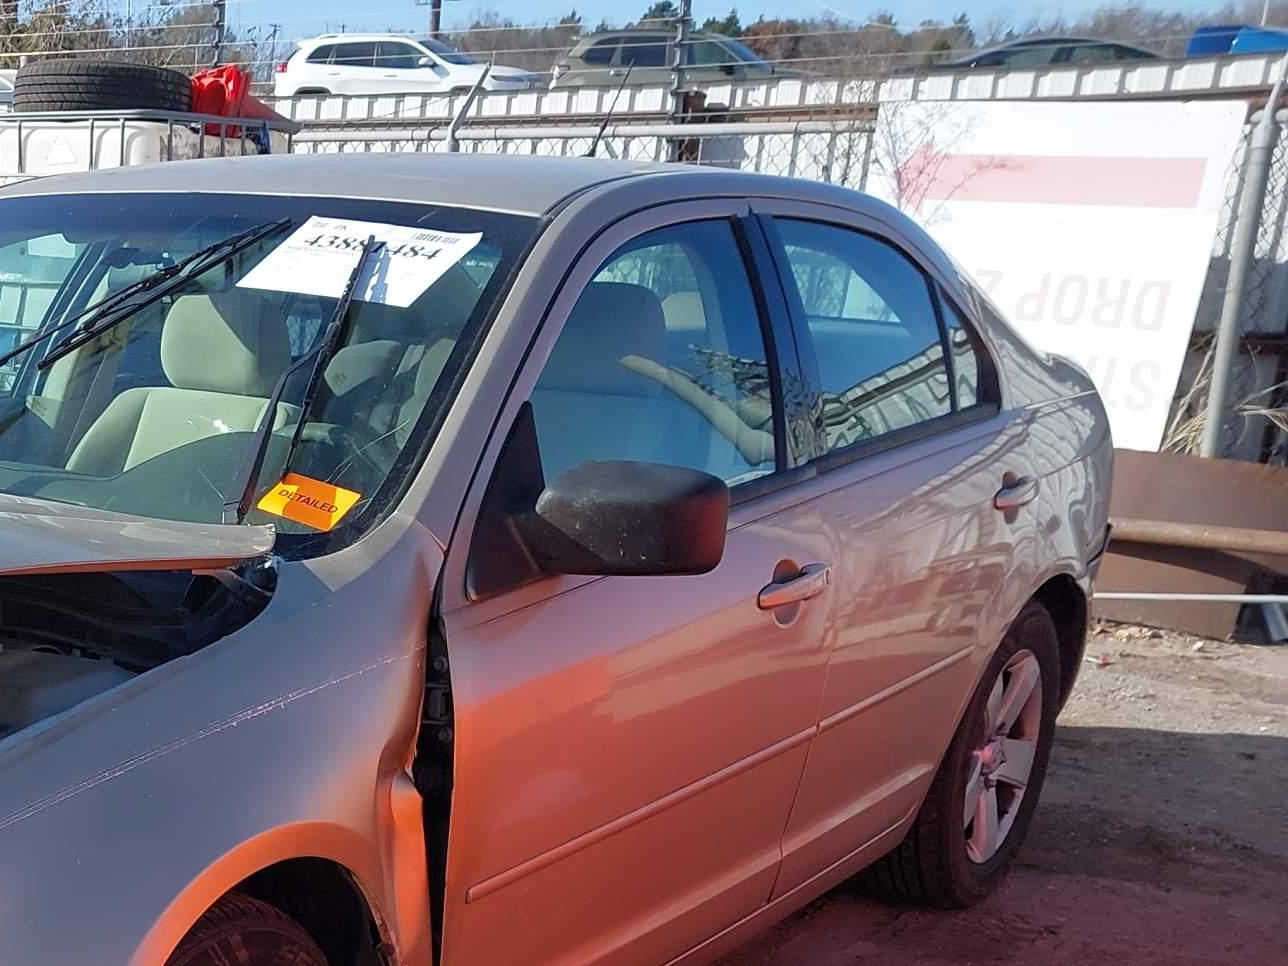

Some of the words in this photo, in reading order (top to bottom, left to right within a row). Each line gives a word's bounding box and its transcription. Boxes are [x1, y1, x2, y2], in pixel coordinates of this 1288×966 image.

[304, 234, 443, 260] 4388484
[1015, 272, 1172, 332] DROP
[278, 489, 339, 514] DETAILED
